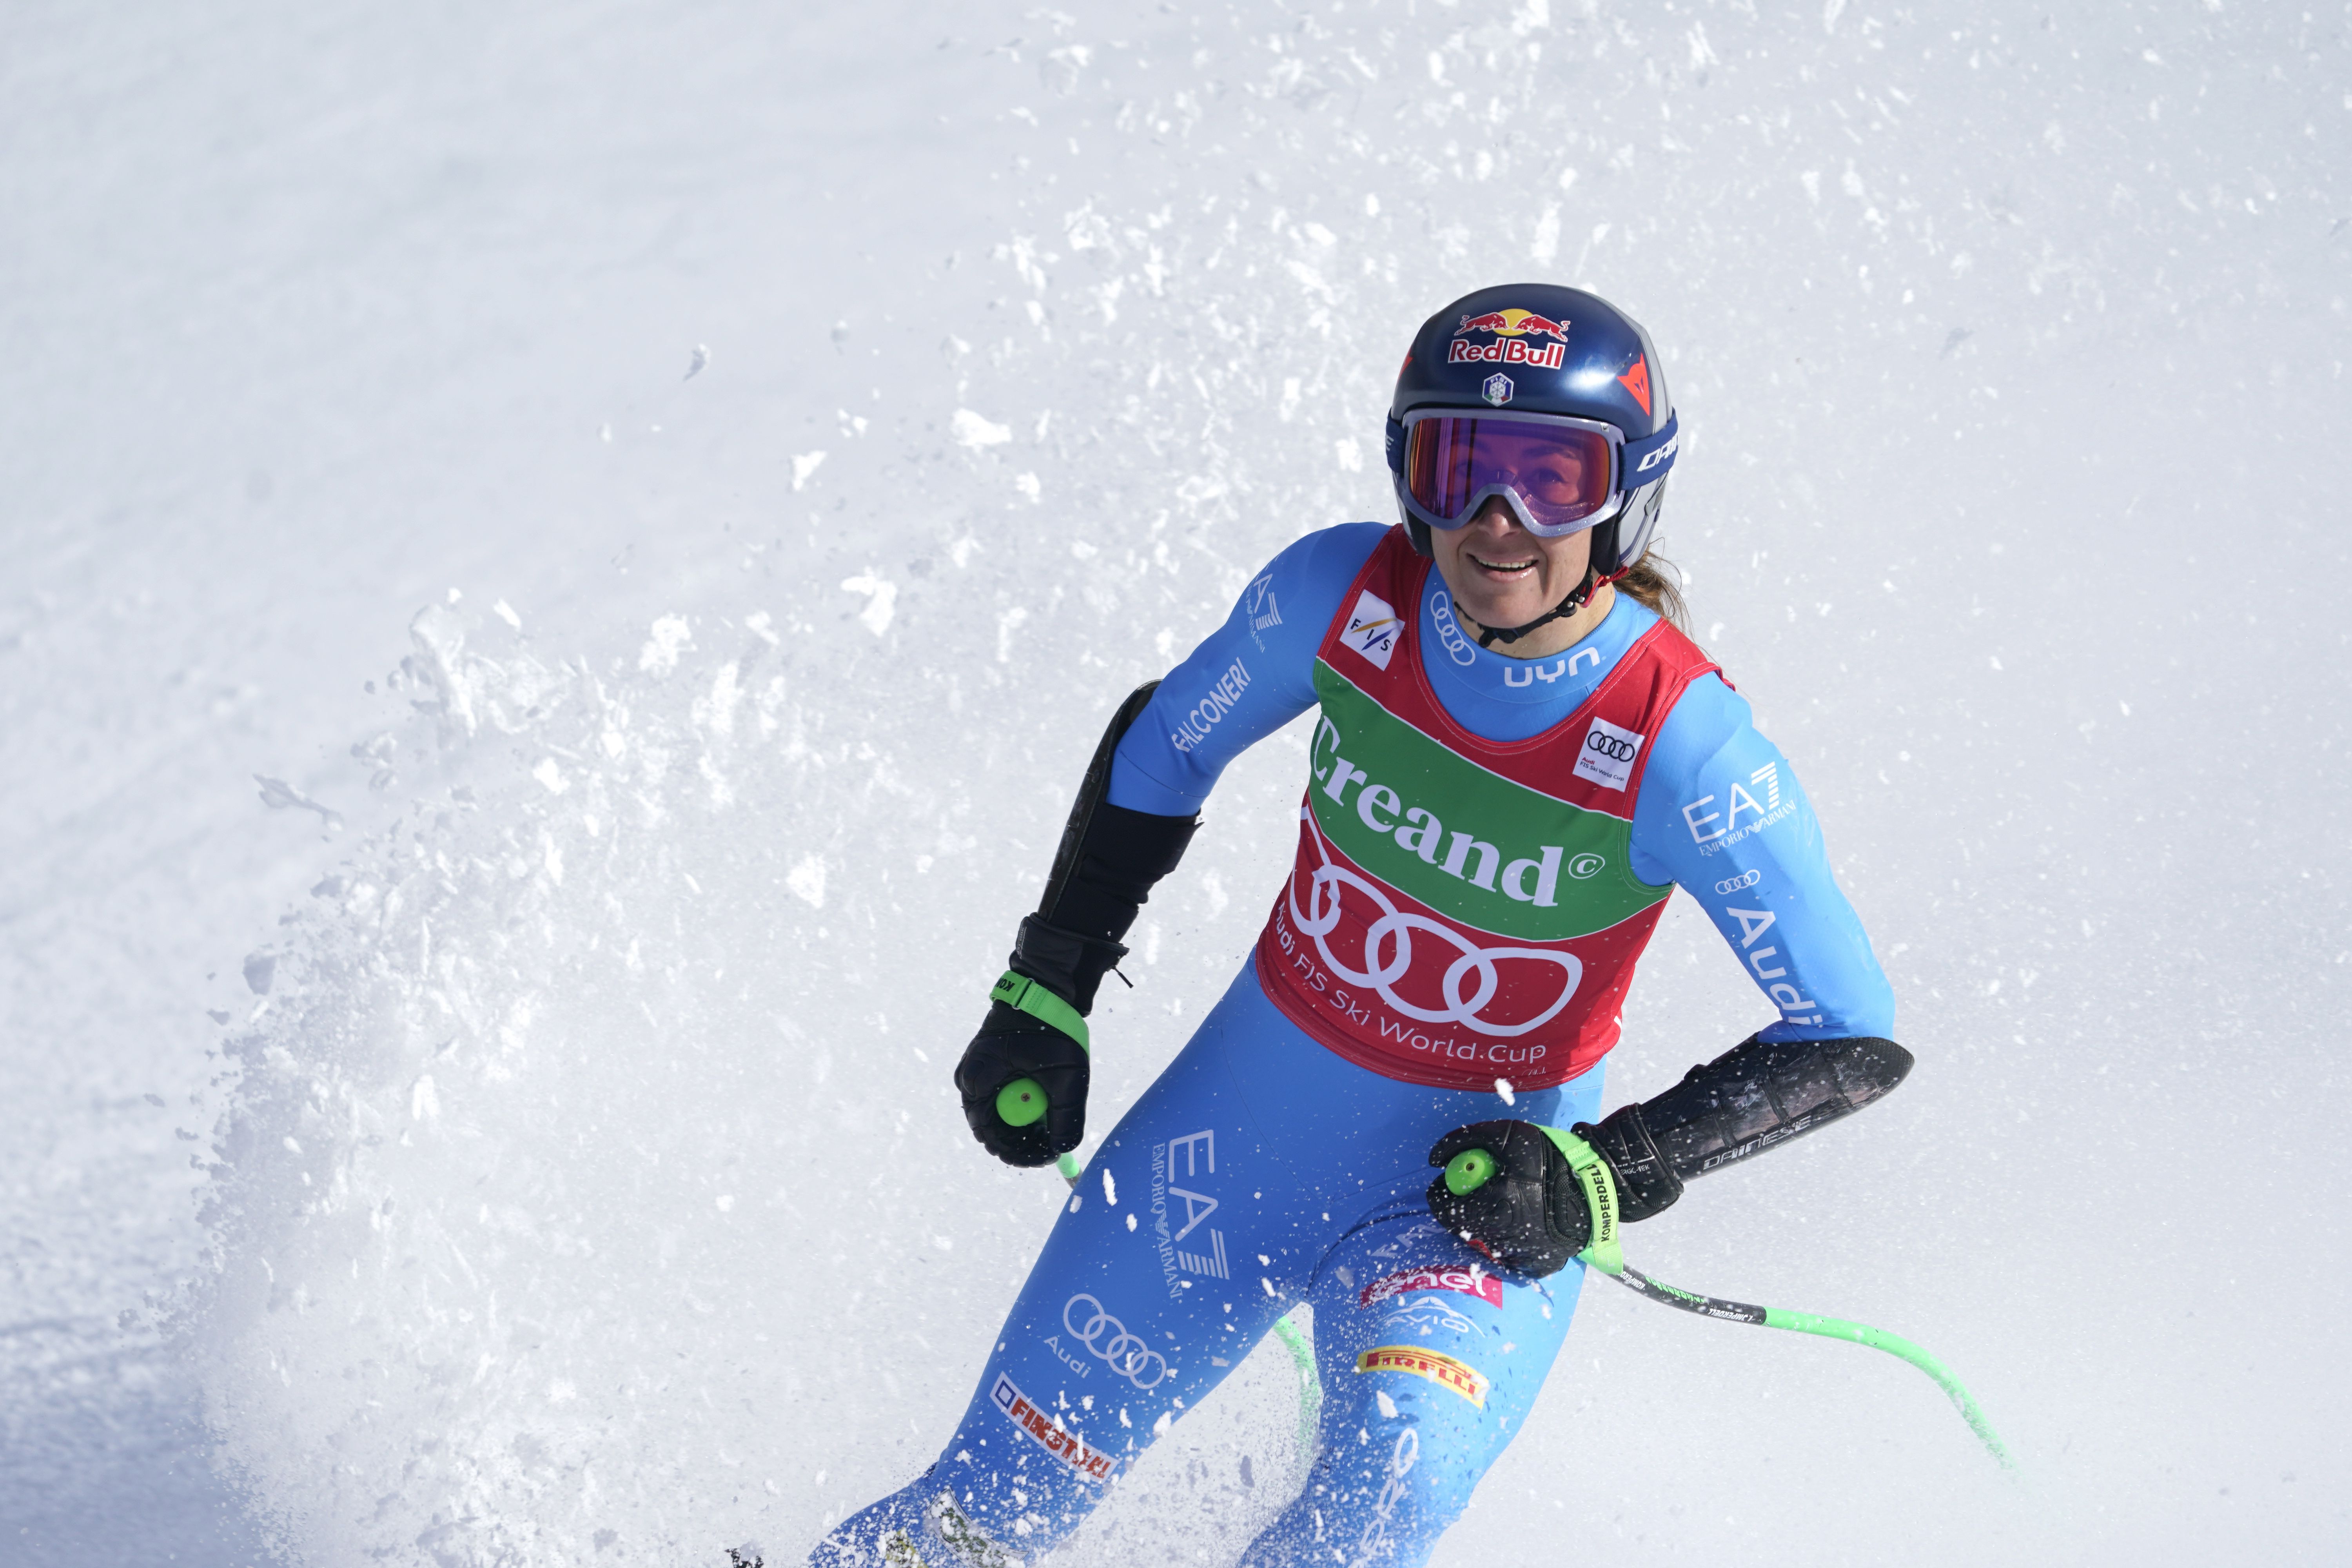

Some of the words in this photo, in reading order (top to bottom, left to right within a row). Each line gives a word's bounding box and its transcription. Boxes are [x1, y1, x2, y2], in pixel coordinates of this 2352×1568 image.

[1449, 338, 1505, 363] Red
[1504, 339, 1565, 369] Bull
[1171, 656, 1251, 753] FALCONERI
[1599, 768, 1612, 778] World
[1682, 761, 1780, 844] EA7
[1314, 715, 1563, 907] Creand
[1699, 827, 1749, 856] EMPORIO
[1763, 799, 1797, 828] ARMANI
[1276, 900, 1296, 956] Audi
[1294, 953, 1328, 991] FIS
[1329, 990, 1371, 1026] Ski
[1380, 1016, 1477, 1060] World
[1489, 1044, 1547, 1064] Cup
[1726, 907, 1823, 1025] Audi
[1151, 1142, 1166, 1214] EMPORIO
[1169, 1129, 1230, 1280] EA7
[1157, 1236, 1183, 1299] ARMANI
[1043, 1336, 1091, 1378] Audi
[1366, 1350, 1484, 1396] PIRELLI
